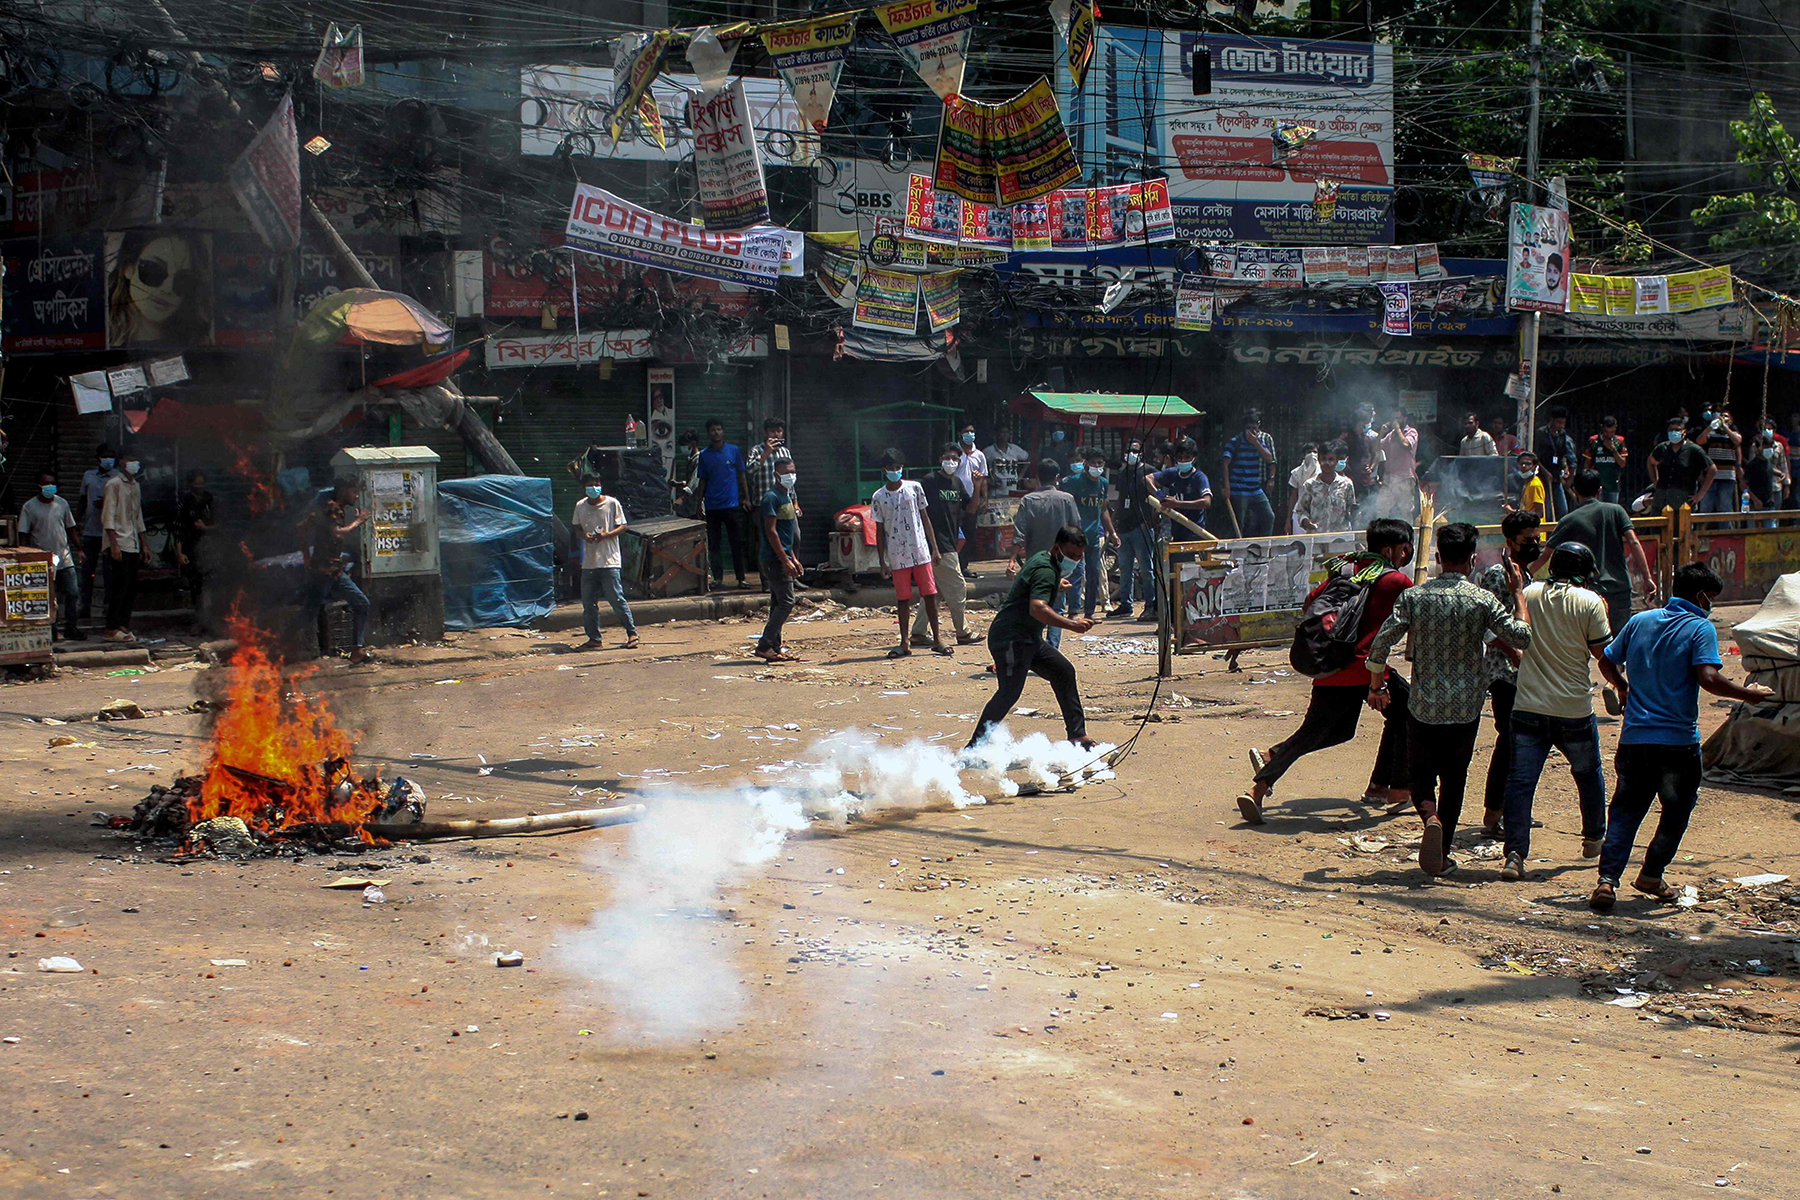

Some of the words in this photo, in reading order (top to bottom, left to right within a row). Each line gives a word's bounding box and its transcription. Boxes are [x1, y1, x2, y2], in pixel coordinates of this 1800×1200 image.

[887, 1, 932, 27] ফিউচার
[770, 29, 811, 48] ফিউচার
[814, 19, 852, 42] ক্যাডেট
[1221, 47, 1277, 71] জেড
[1282, 42, 1369, 83] টাওয়ার
[795, 73, 830, 86] 01896-227610
[1169, 119, 1188, 132] সুবিধা
[1319, 120, 1325, 130] ও
[1329, 114, 1357, 132] অফিস
[858, 193, 892, 208] BBS
[1203, 203, 1233, 217] সেন্টার
[1254, 204, 1289, 219] মেসার্স
[573, 194, 652, 236] ICON
[661, 219, 742, 255] PLUS
[654, 243, 664, 252] 50
[747, 244, 759, 255] ভর্তি
[760, 247, 779, 261] কোচিং
[711, 256, 720, 265] 65
[1438, 321, 1467, 331] থেকে
[494, 340, 596, 362] মিরপুর
[1234, 342, 1484, 367] এন্টারপ্রাইজ
[378, 538, 400, 549] HSC
[6, 572, 31, 587] HSC
[8, 600, 32, 613] HSC
